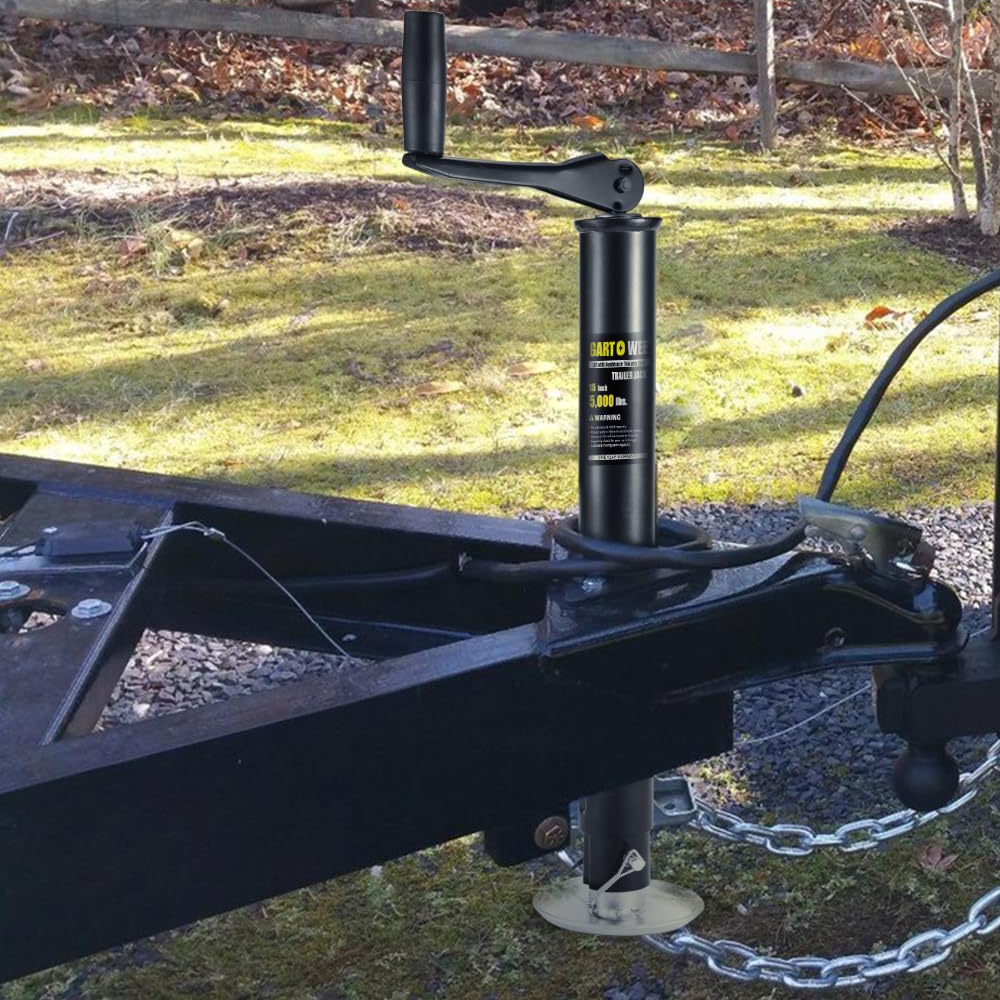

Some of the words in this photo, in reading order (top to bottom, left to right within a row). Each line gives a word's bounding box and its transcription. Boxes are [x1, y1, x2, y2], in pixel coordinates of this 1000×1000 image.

[611, 371, 633, 380] TRAILER
[589, 394, 614, 408] 5,000
[594, 413, 621, 421] WARNING
